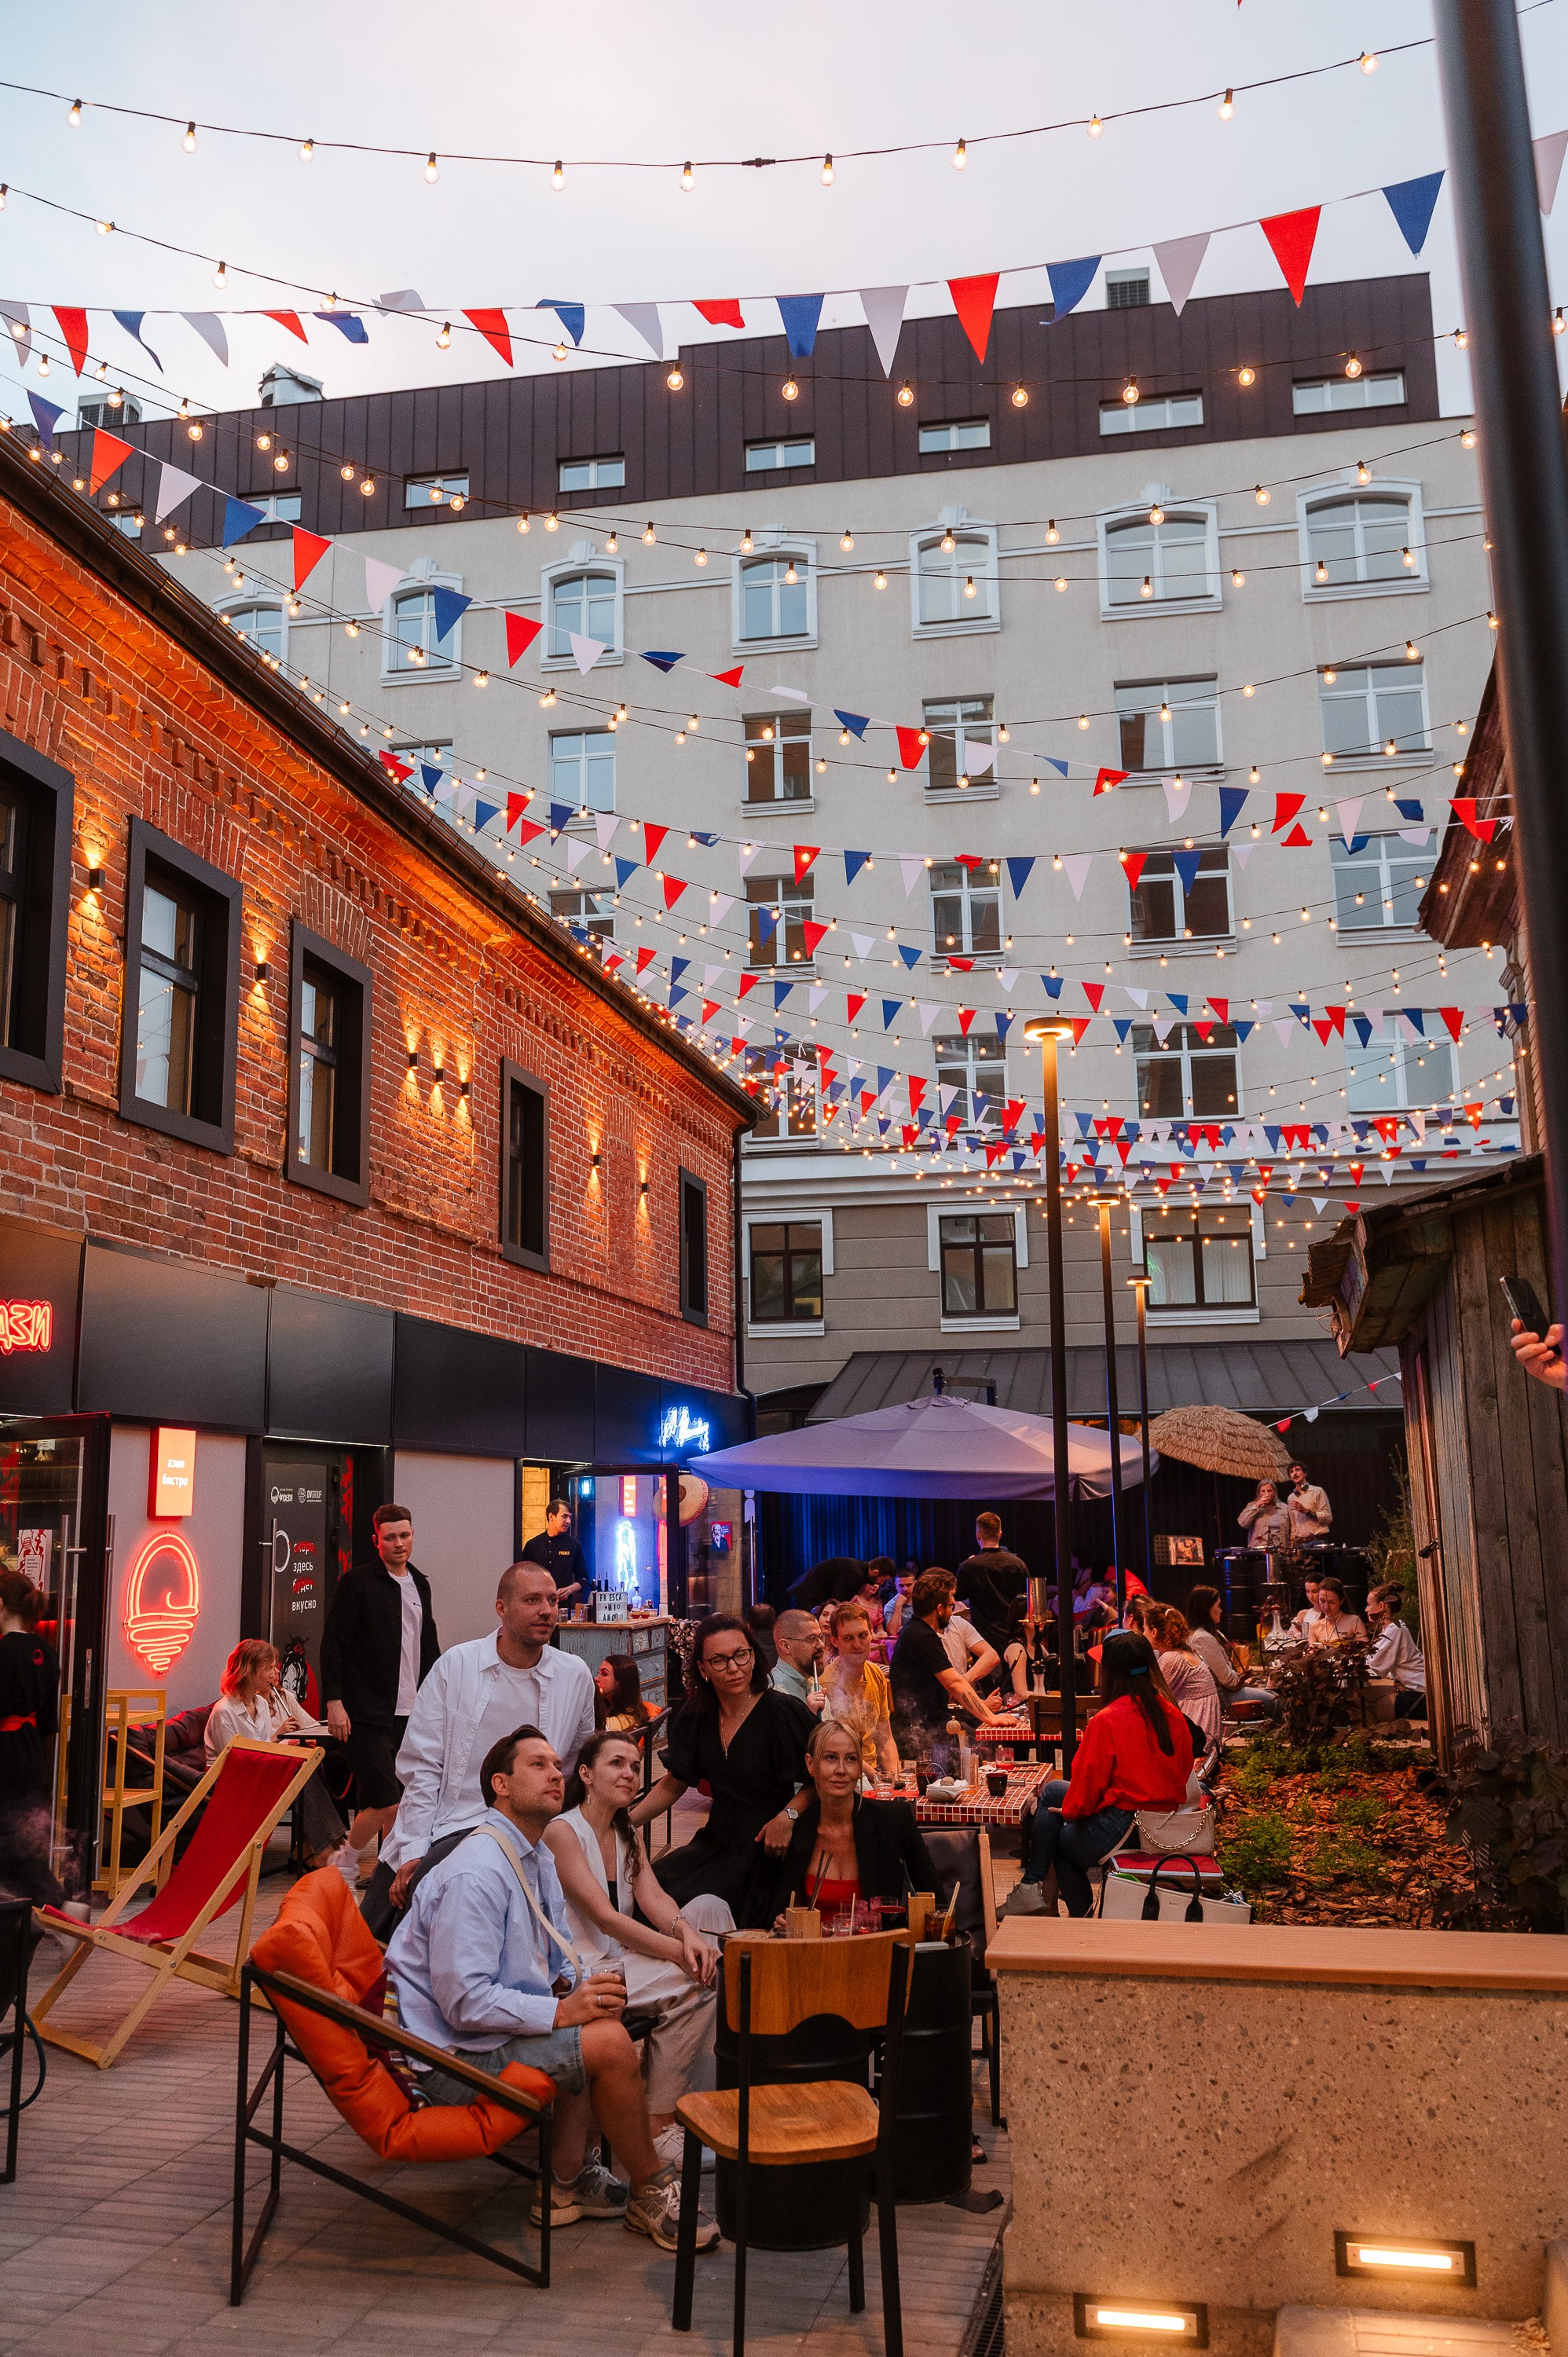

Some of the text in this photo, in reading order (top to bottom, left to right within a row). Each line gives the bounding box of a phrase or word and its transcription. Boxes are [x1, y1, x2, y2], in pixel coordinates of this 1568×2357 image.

[162, 1473, 189, 1489] бистро
[292, 1561, 313, 1574] здесь
[291, 1599, 317, 1613] вкусно
